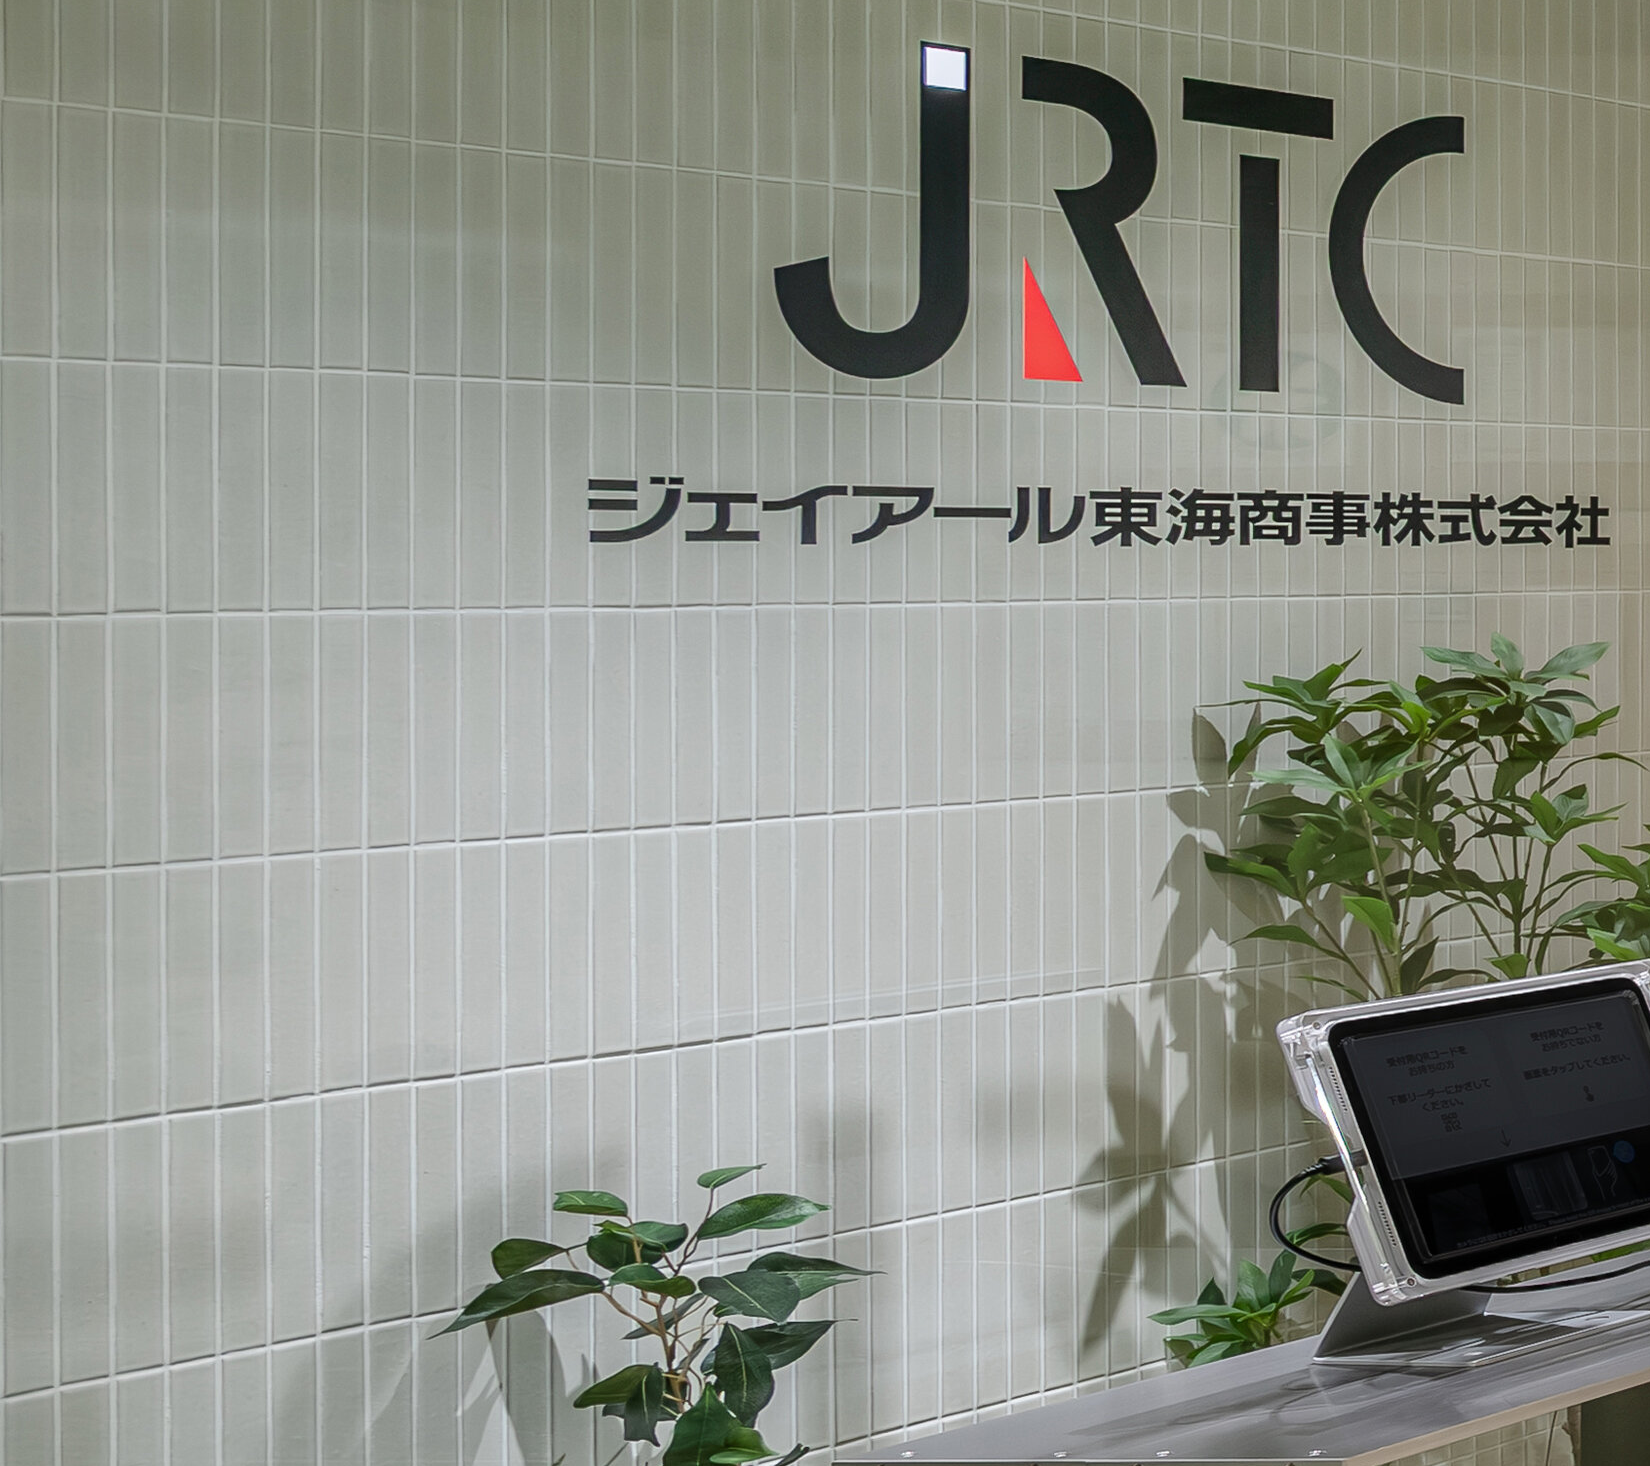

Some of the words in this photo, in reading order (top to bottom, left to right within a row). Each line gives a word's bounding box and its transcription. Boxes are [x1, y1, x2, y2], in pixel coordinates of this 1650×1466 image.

[773, 41, 1465, 405] JRTC
[587, 476, 1611, 548] ジェイアール東海商事株式会社
